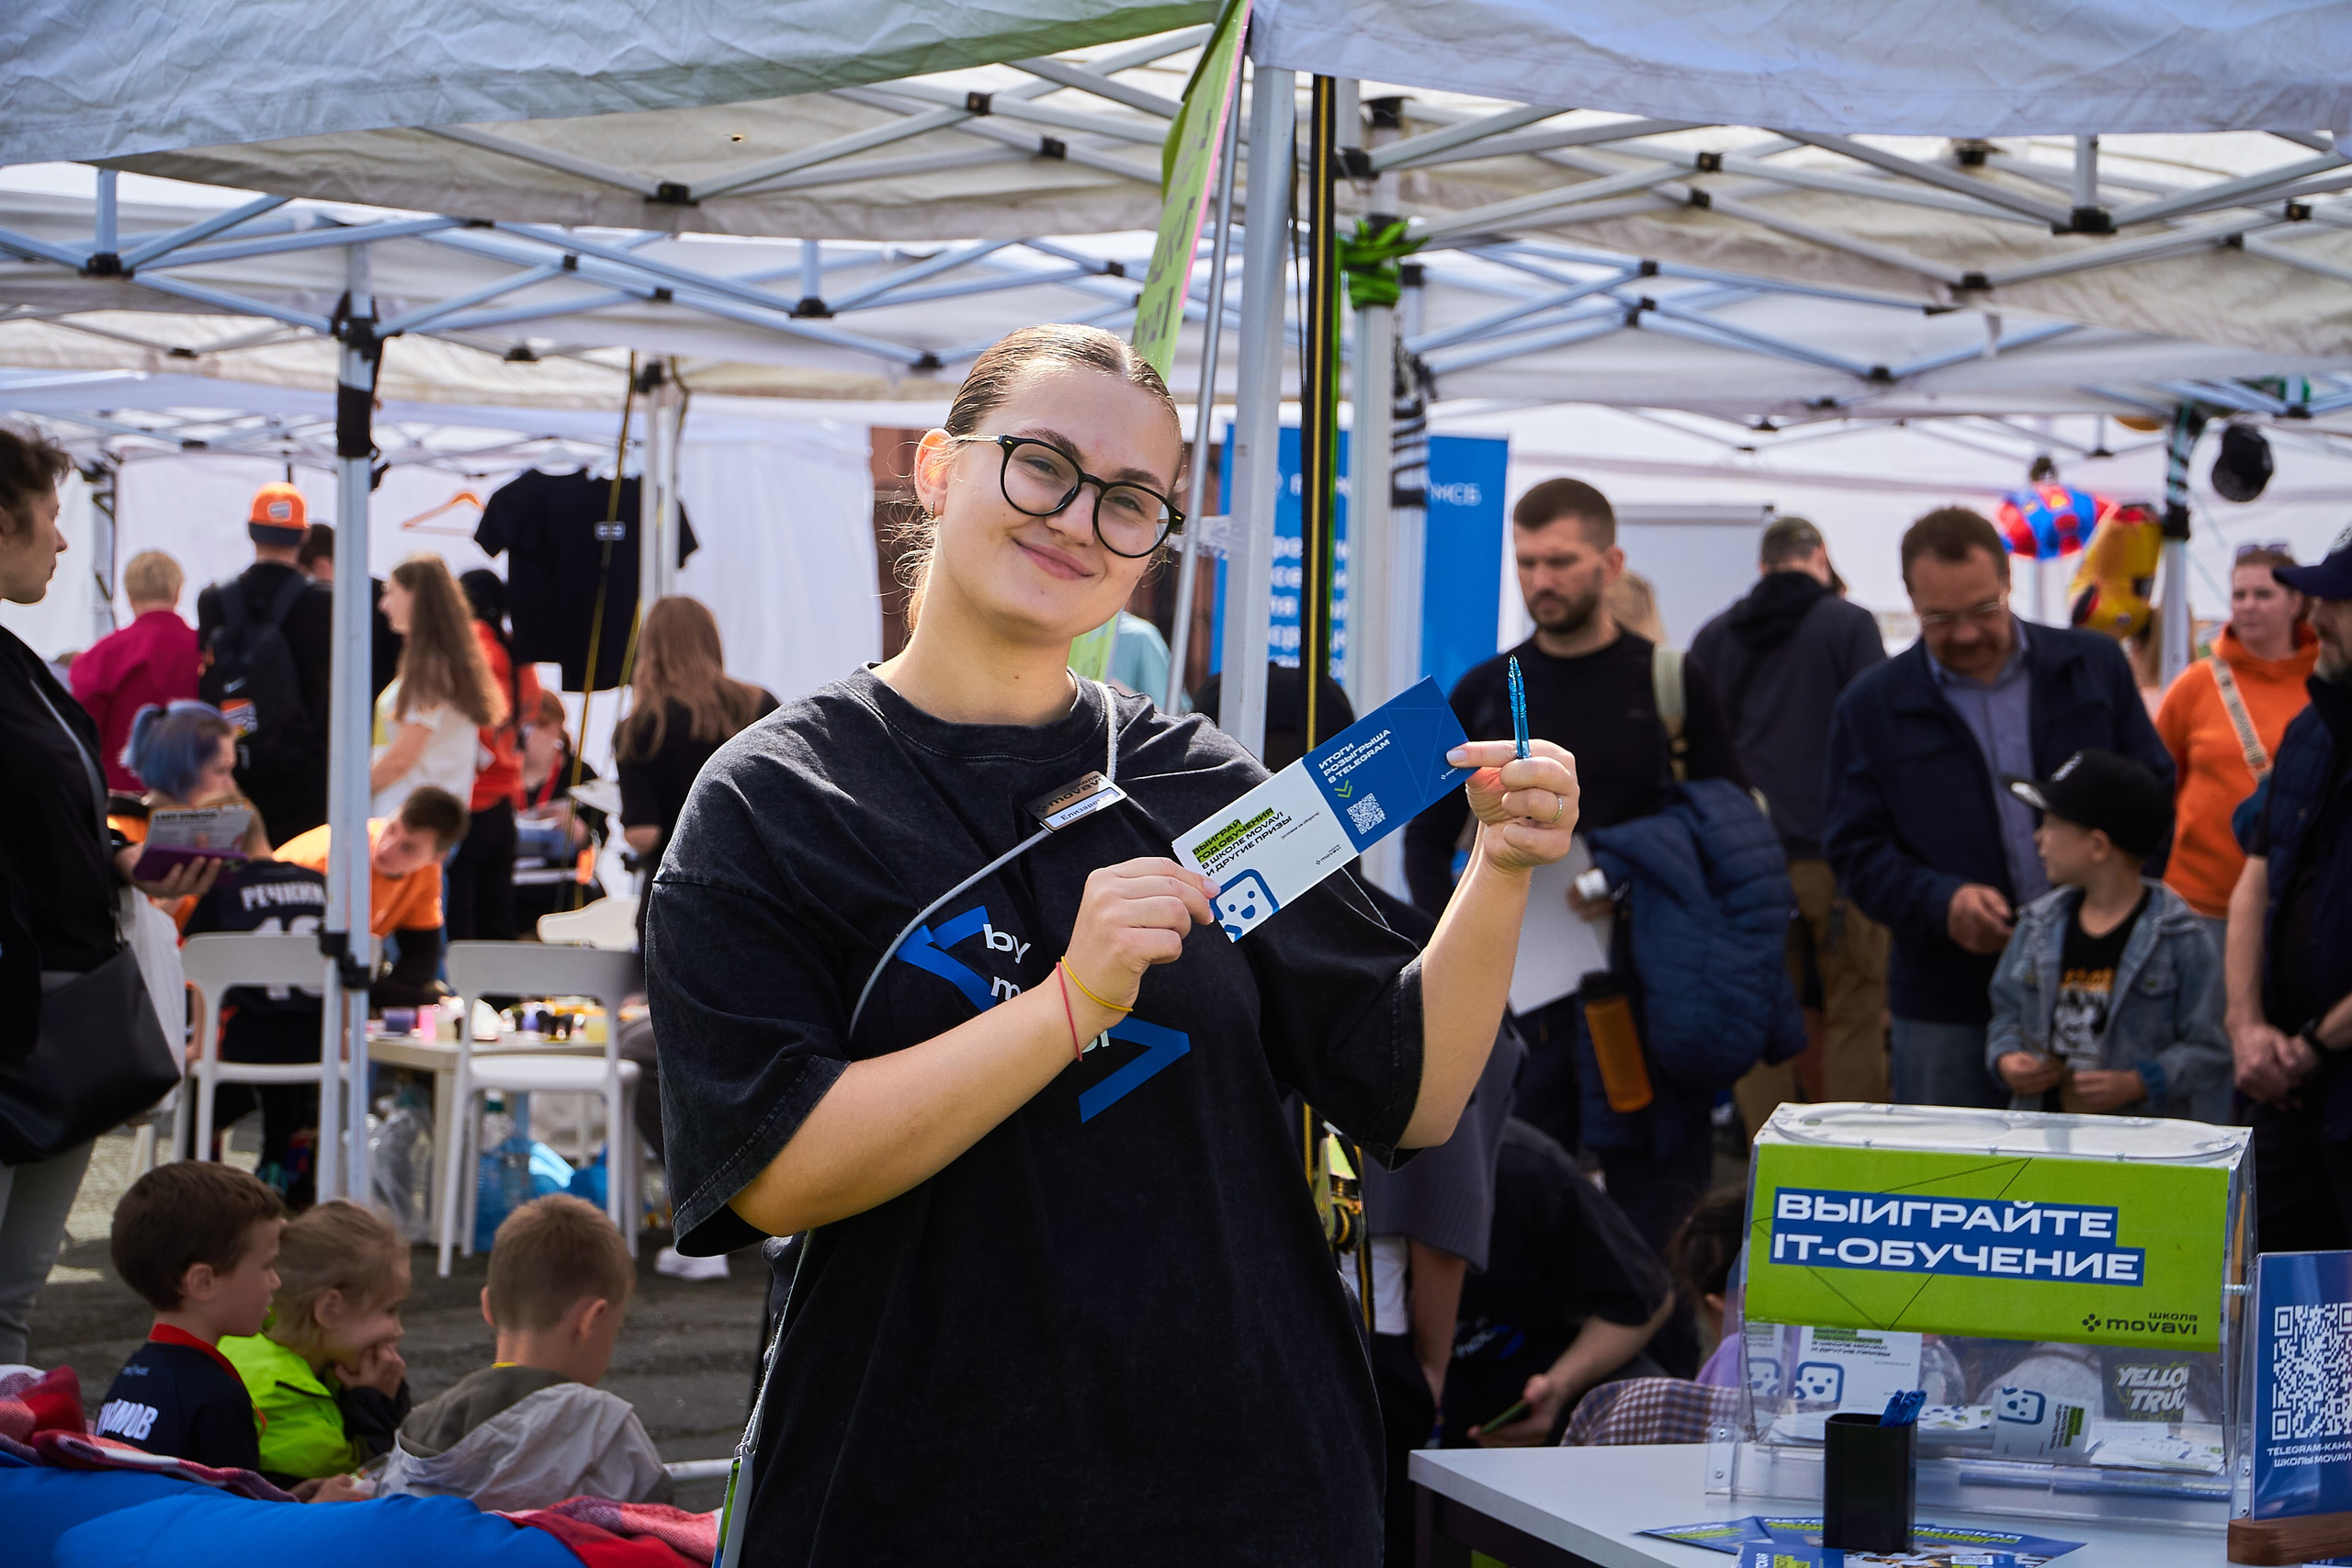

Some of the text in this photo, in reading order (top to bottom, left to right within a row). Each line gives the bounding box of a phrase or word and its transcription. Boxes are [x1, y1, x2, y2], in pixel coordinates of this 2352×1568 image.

[1318, 742, 1354, 770] ИТОГИ
[1323, 728, 1391, 776] РОЗЫГРЫША
[1327, 739, 1391, 784] В TELEGRAM
[1060, 796, 1107, 820] Елизавет
[1192, 818, 1242, 855] ВЫИГРАЙ
[1196, 807, 1274, 863] ГОД ОБУЧЕНИЯ
[1202, 811, 1283, 870] В ШКОЛЕ MOVAVI
[1206, 816, 1292, 876] И ДРУГИЕ ПРИЗЫ
[983, 923, 1032, 964] by
[1777, 1193, 2113, 1238] ВЫИГРАЙТЕ
[1773, 1234, 2140, 1281] IT-ОБУЧЕНИЕ
[2107, 1318, 2198, 1336] movavi
[2148, 1312, 2199, 1321] школа
[2274, 1452, 2352, 1468] ШКОЛЫ MOVAVI
